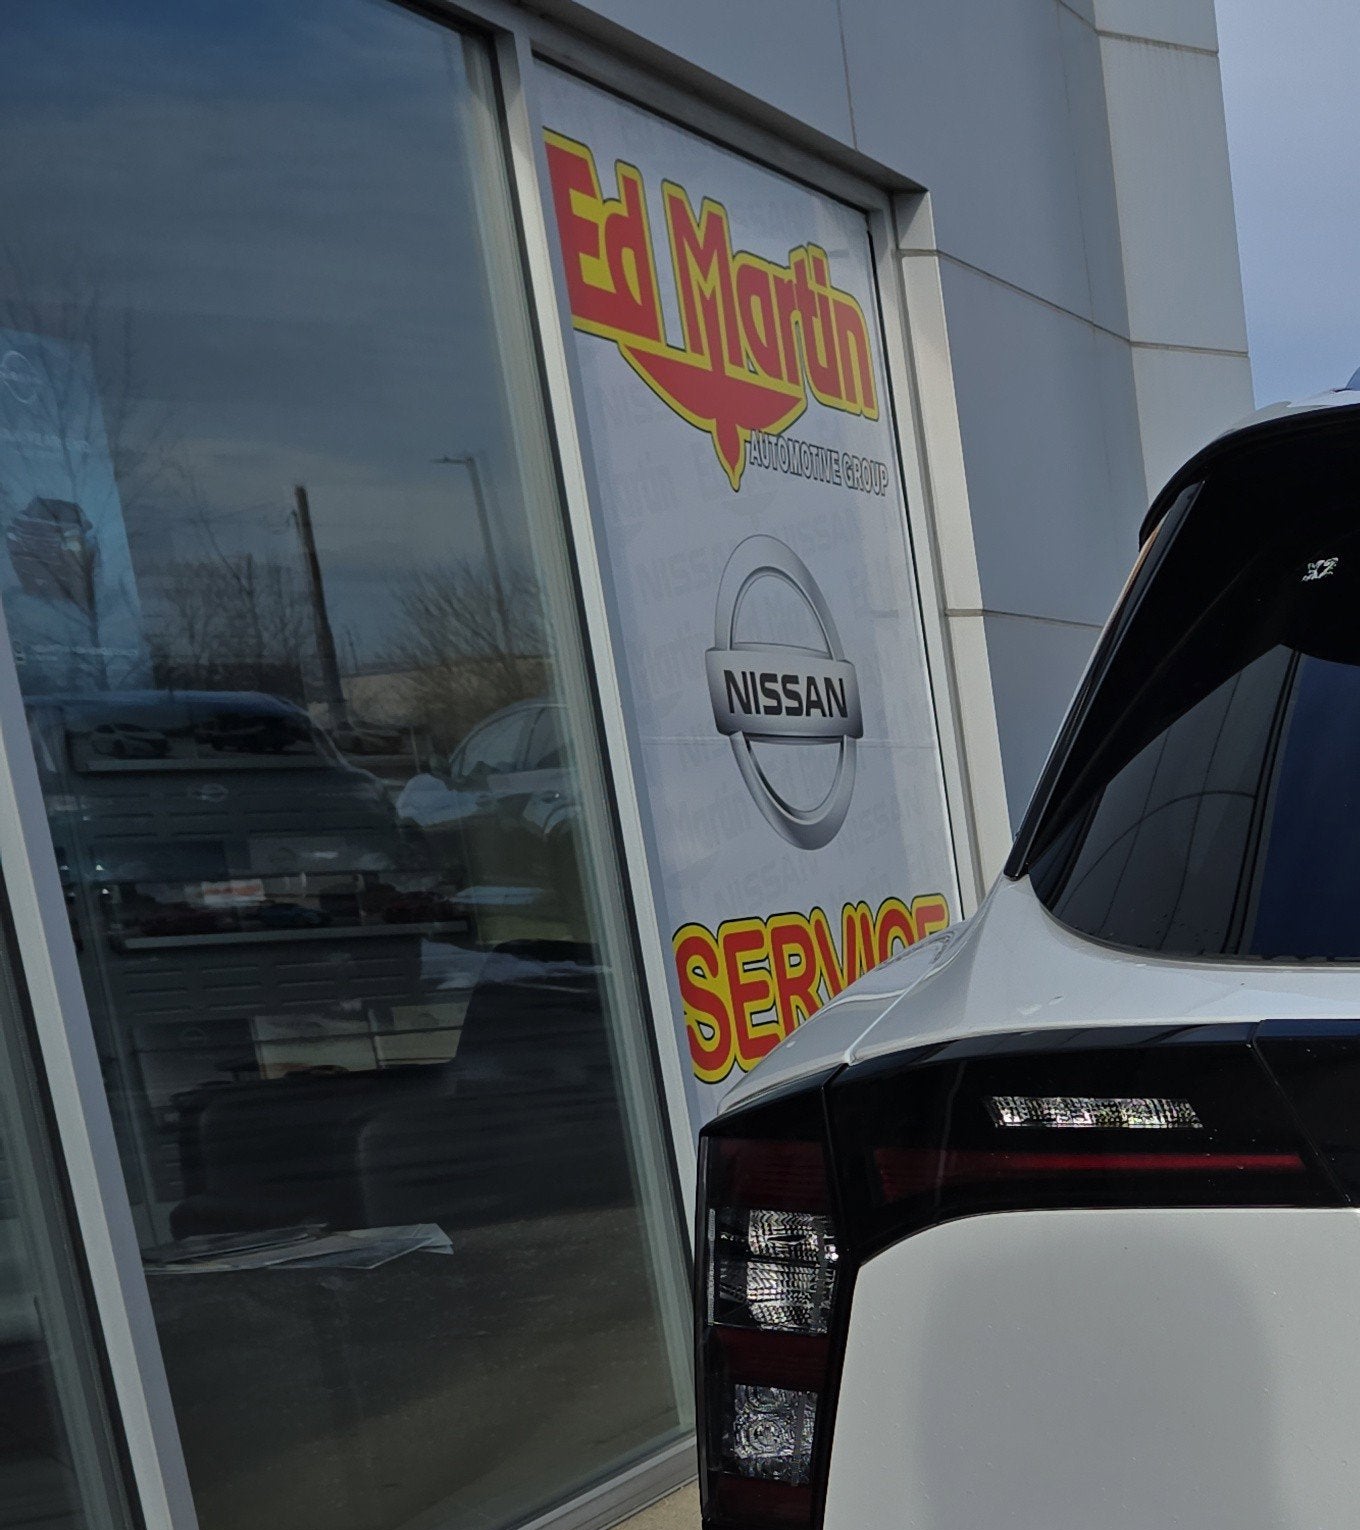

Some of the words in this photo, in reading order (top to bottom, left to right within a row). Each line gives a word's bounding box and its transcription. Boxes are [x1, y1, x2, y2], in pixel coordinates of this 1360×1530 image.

[543, 126, 668, 350] Ed
[661, 178, 879, 422] Martin
[750, 430, 842, 485] AUTOMOTIVE
[843, 452, 889, 497] GROUP
[723, 669, 848, 718] NISSAN
